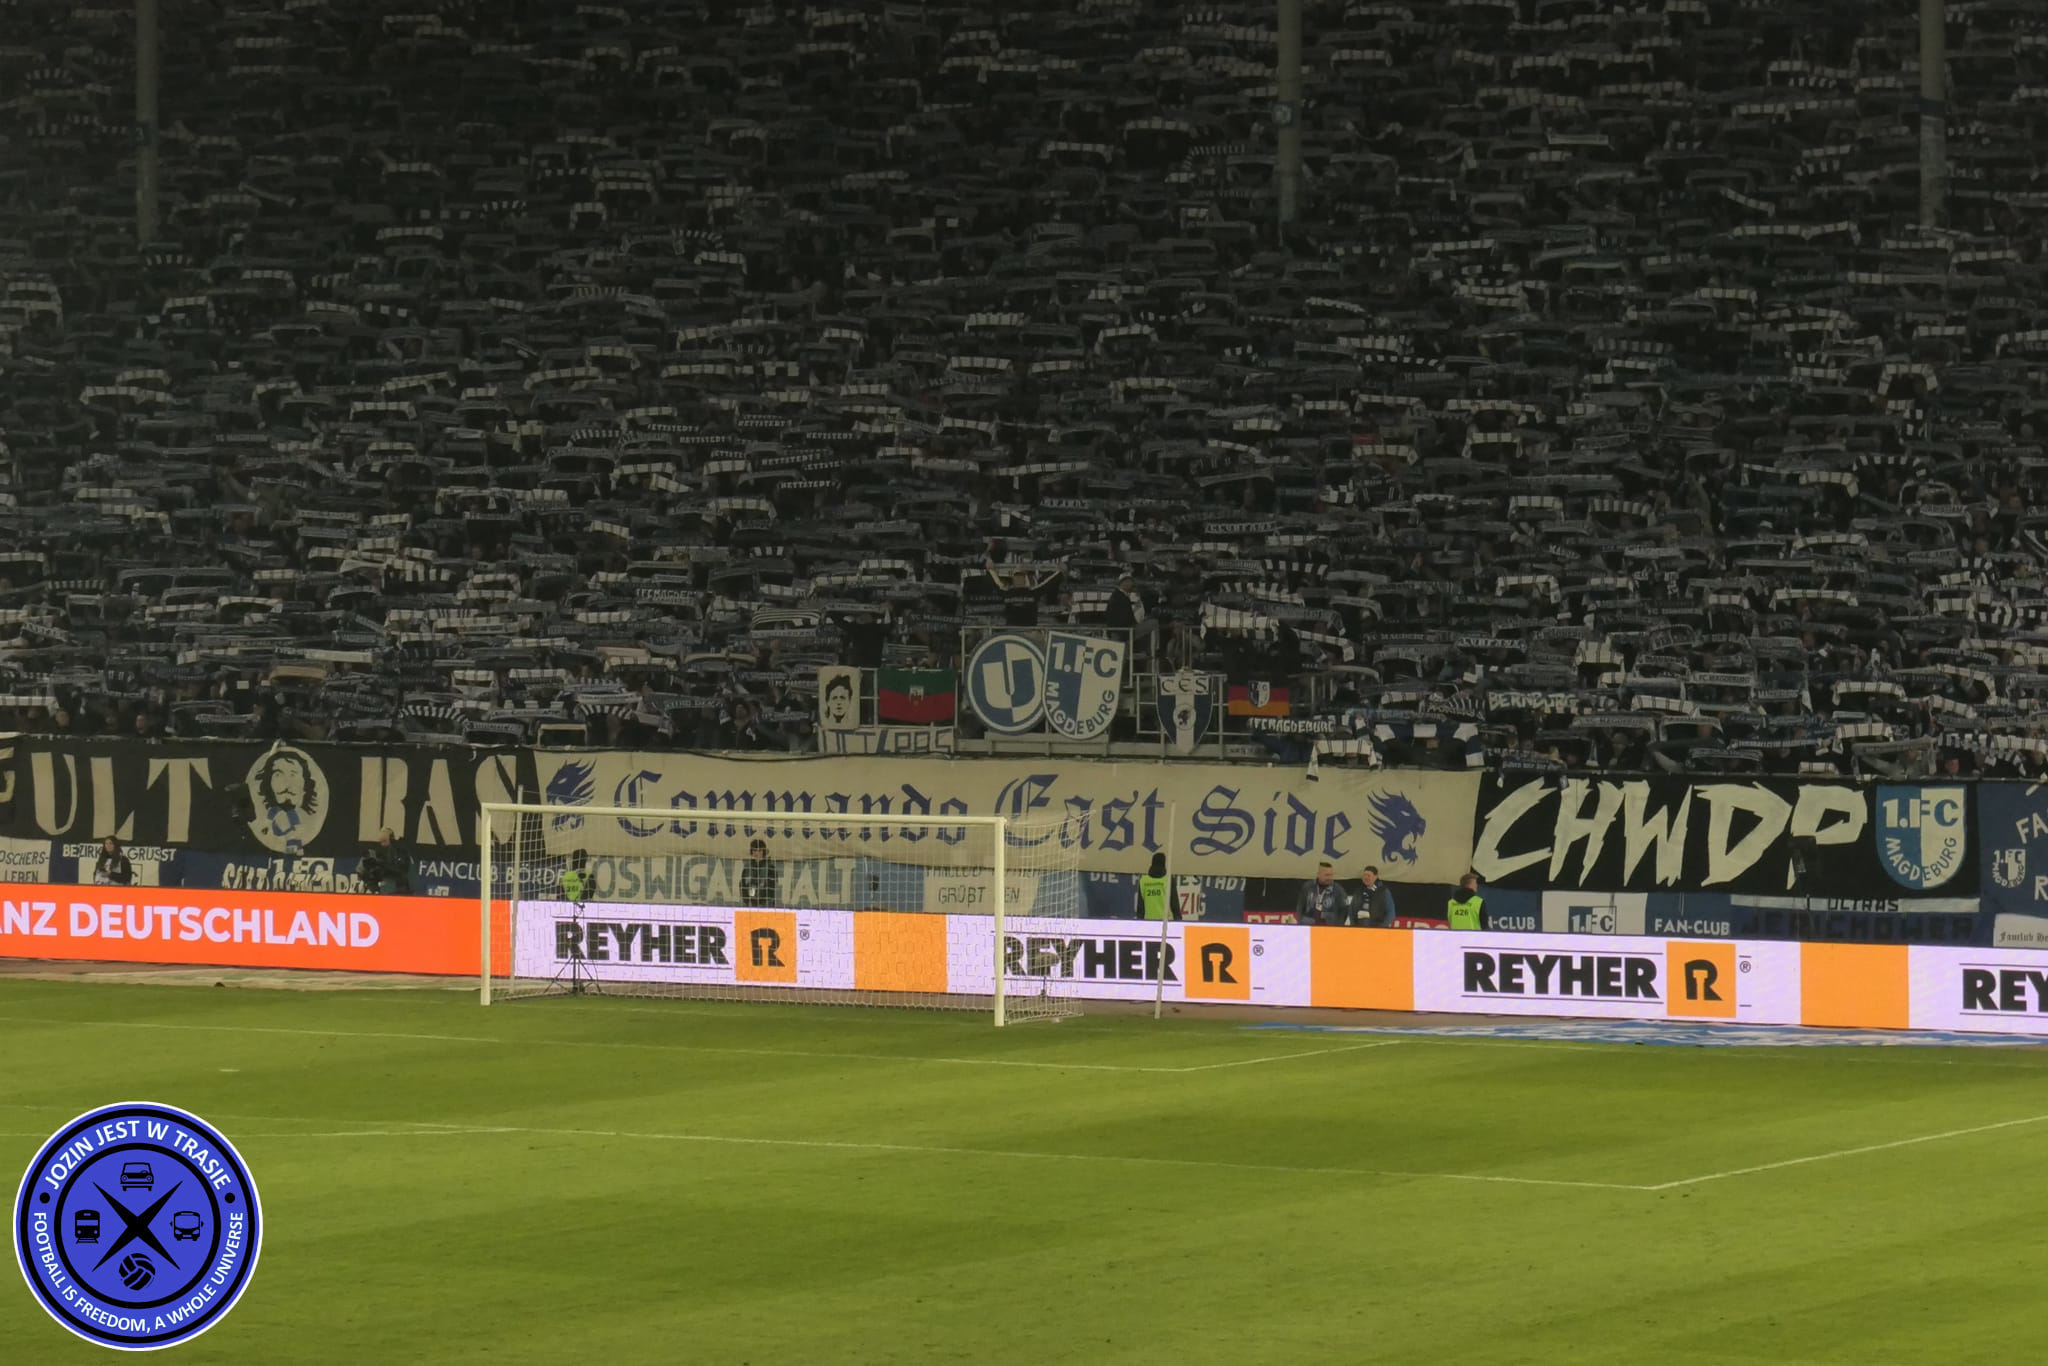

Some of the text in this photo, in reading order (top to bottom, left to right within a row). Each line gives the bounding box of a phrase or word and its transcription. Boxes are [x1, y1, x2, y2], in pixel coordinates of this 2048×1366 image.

[1051, 642, 1118, 678] 1.FC
[1161, 677, 1208, 693] CES
[1046, 681, 1115, 735] MAGDEBURG
[614, 769, 1352, 860] Commando East Side
[1883, 799, 1959, 829] 1.FC
[592, 855, 703, 900] OSWIG
[1886, 837, 1957, 882] MAGDEBURG
[0, 900, 381, 948] NZ DEUTSCHLAND
[555, 921, 730, 966] REYHER
[1488, 916, 1536, 930] N-CLUB
[1654, 917, 1731, 936] FAN-CLUB
[1000, 937, 1178, 982] REYHER
[1463, 952, 1661, 999] REYHER
